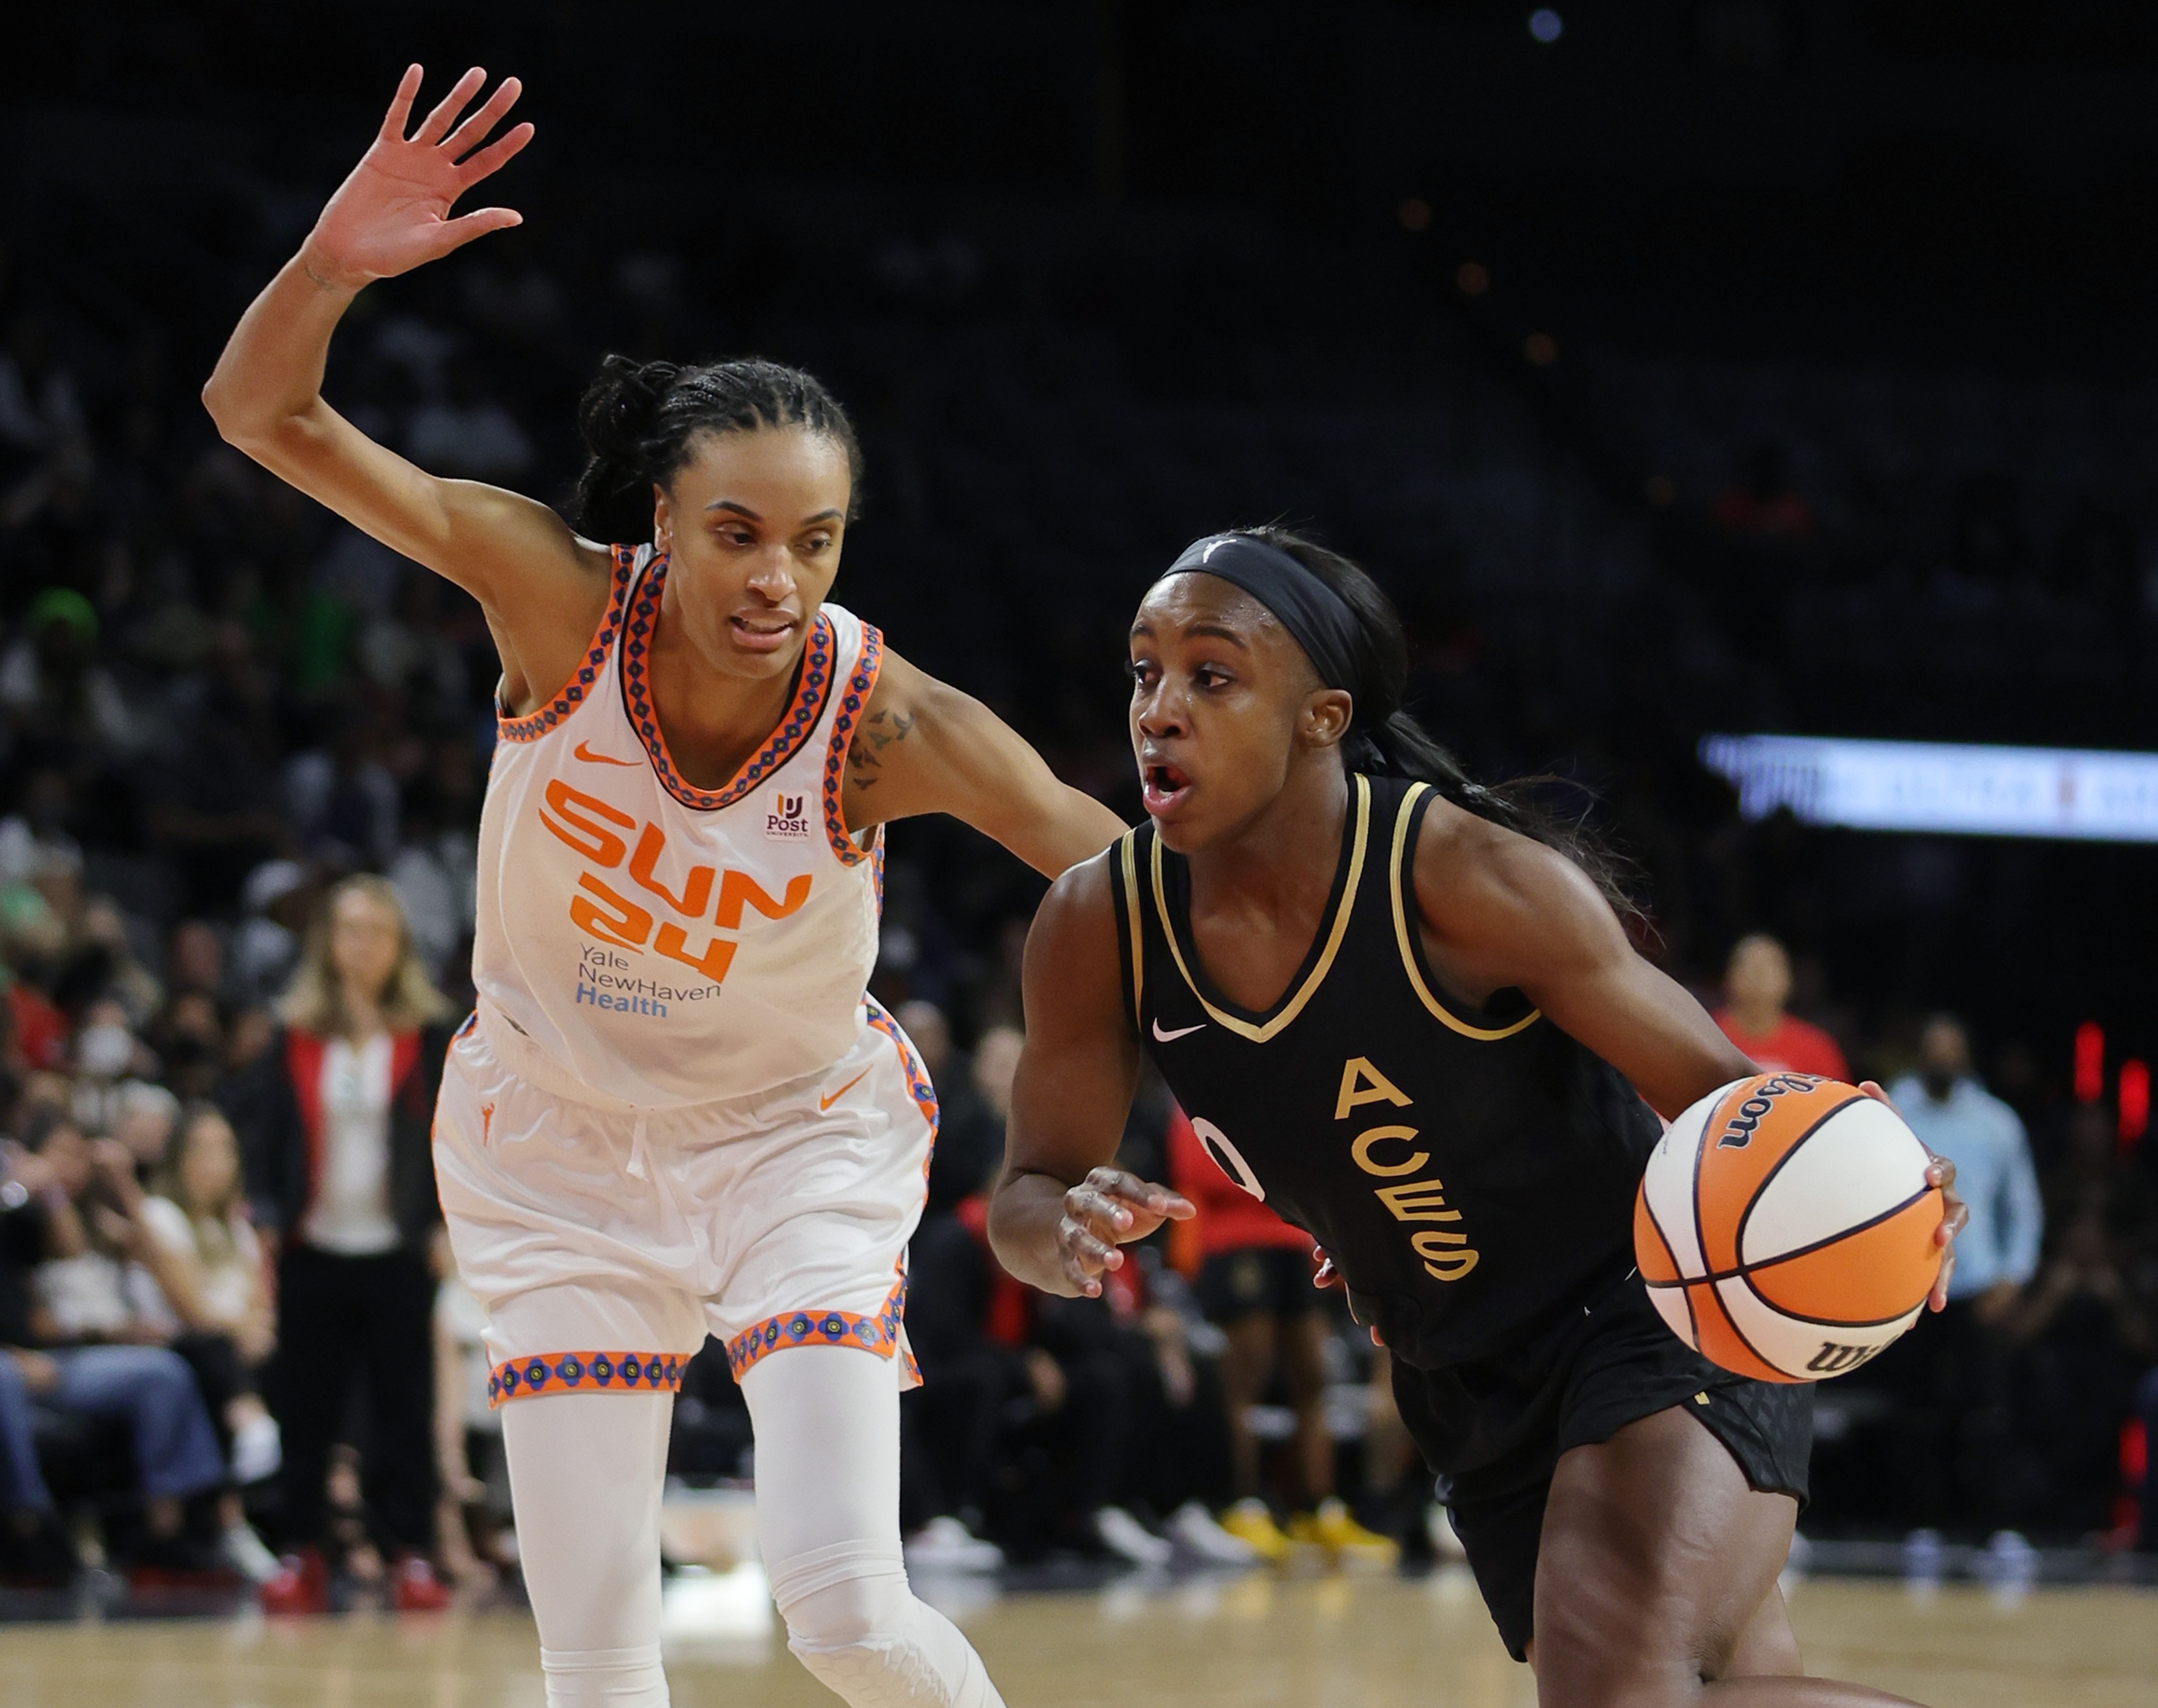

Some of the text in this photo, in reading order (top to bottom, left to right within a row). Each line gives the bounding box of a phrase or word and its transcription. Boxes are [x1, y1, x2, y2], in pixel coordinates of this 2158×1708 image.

[767, 815, 809, 832] Post
[539, 779, 813, 930] SUN
[570, 871, 738, 984] 24
[580, 942, 628, 970] Yale
[576, 982, 668, 1018] Health
[579, 962, 721, 1001] NewHaven
[1334, 1056, 1479, 1281] ACES
